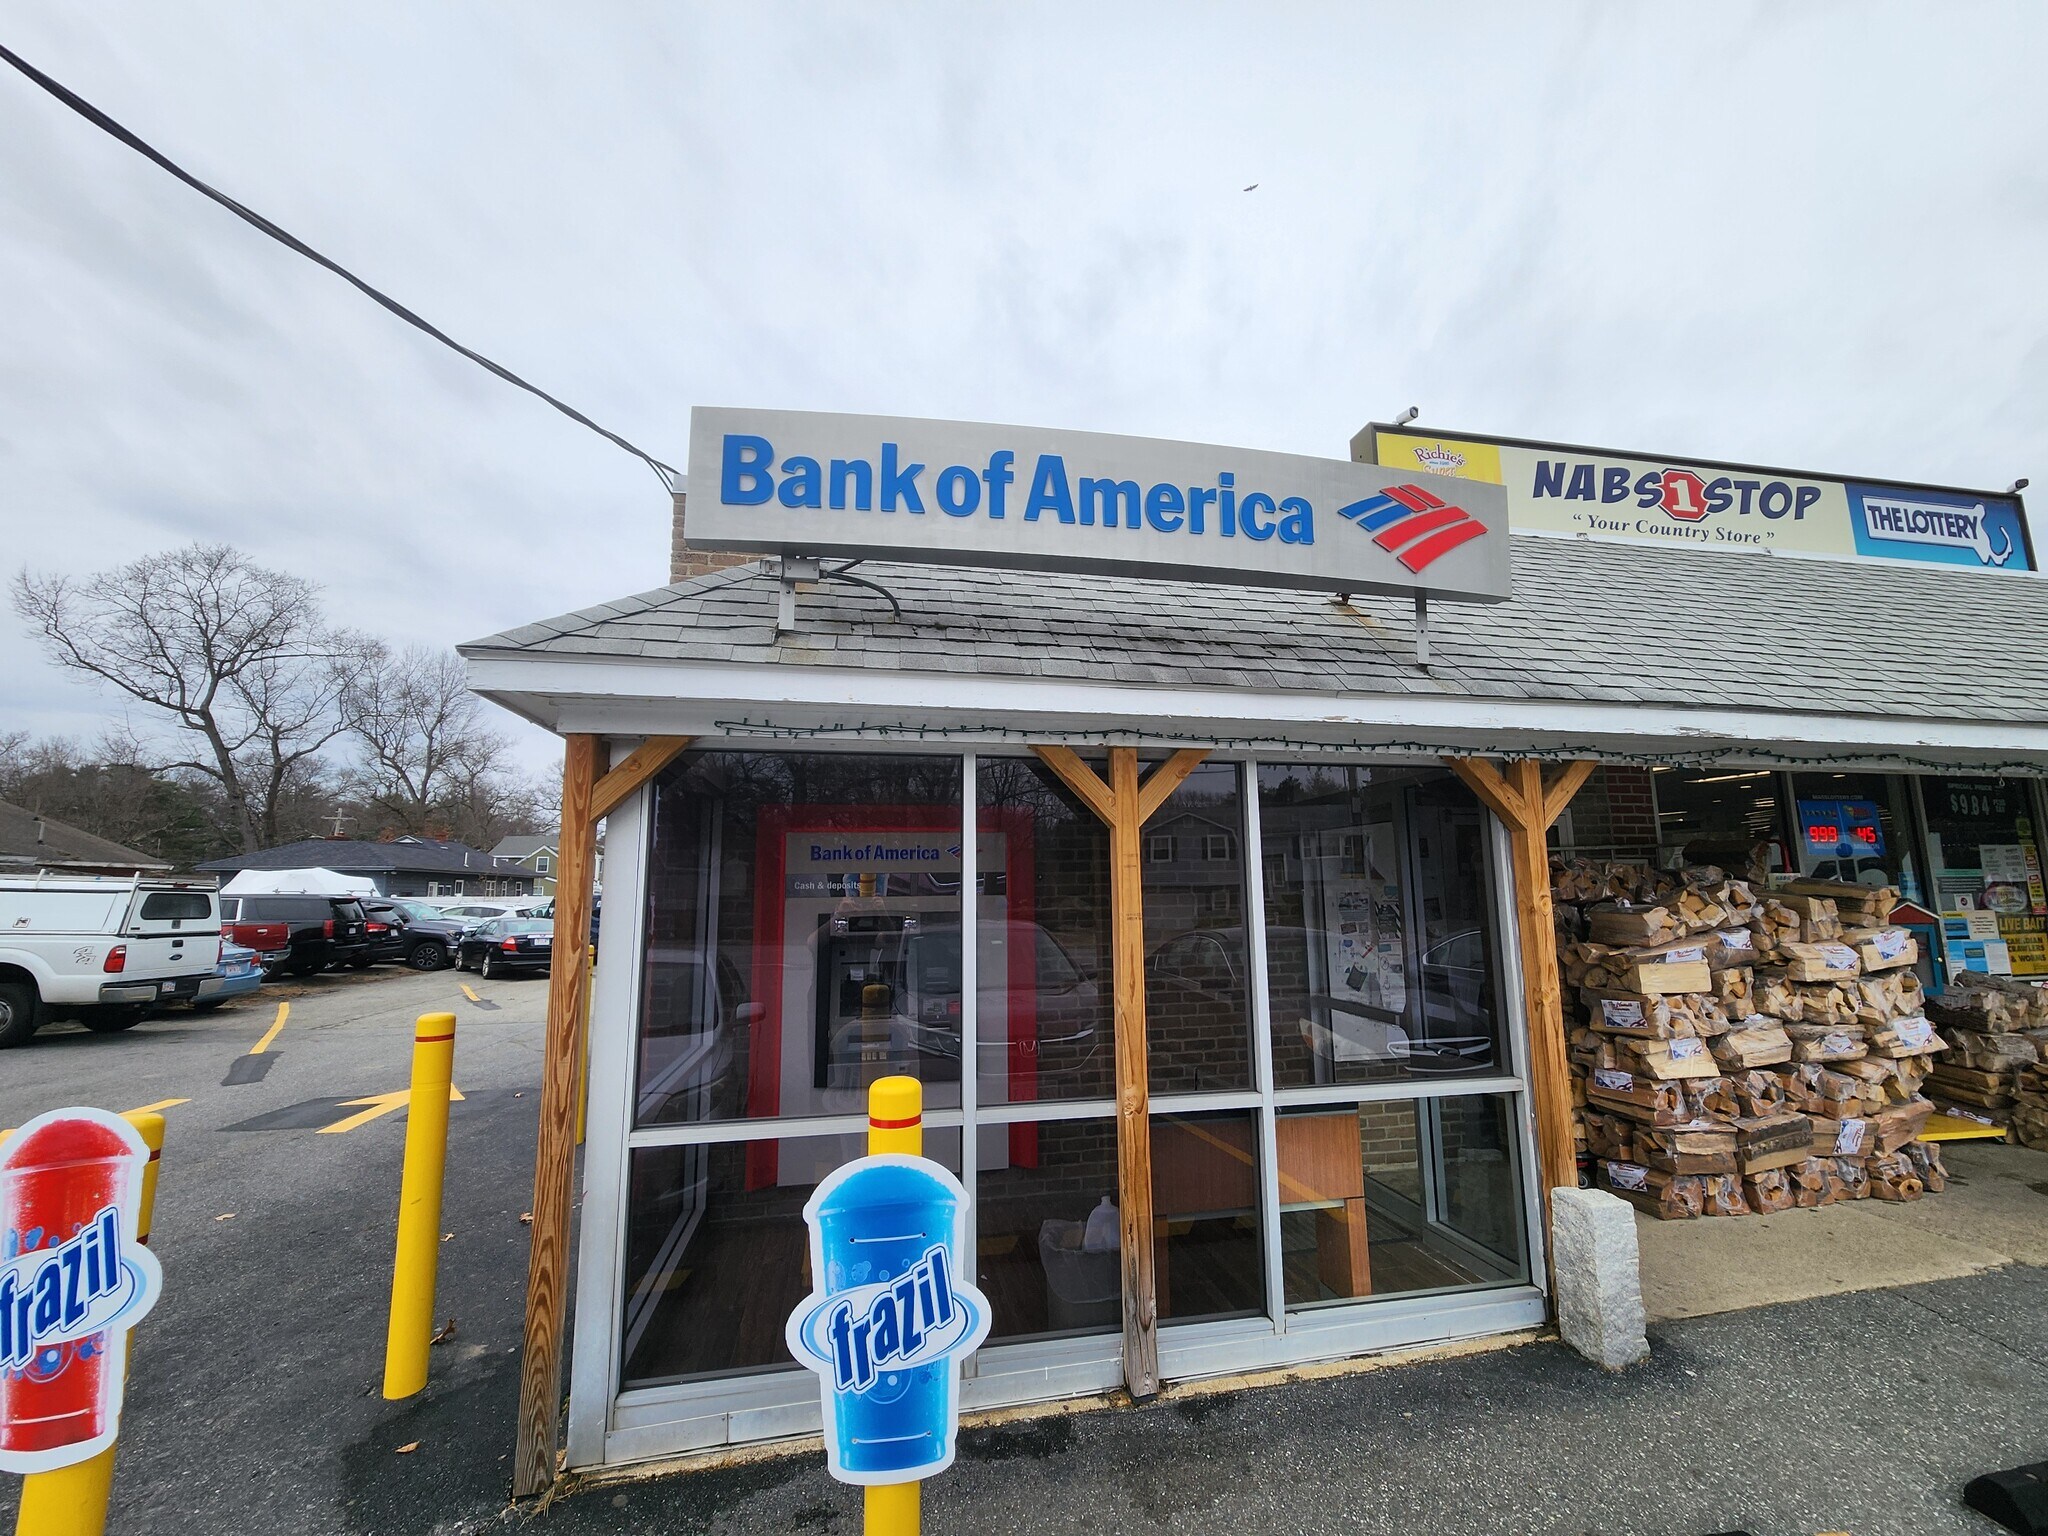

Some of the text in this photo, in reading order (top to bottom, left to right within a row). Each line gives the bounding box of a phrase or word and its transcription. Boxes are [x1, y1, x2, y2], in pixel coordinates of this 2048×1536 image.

[1413, 444, 1465, 466] Richie's
[720, 434, 1314, 546] Bank of America
[1533, 460, 1821, 520] NABS 1 STOP
[1635, 519, 1710, 542] Country
[1867, 505, 1978, 540] THE LOTTERY
[1857, 826, 1876, 843] 45
[810, 845, 940, 860] Bank of America
[794, 880, 861, 891] Cash & deposits
[2000, 917, 2021, 931] LIVE
[2023, 916, 2046, 931] BAIT
[2008, 944, 2045, 952] CRAWLERS
[2018, 954, 2047, 962] WORMS
[0, 1213, 118, 1364] frazil
[831, 1249, 953, 1388] frazil
